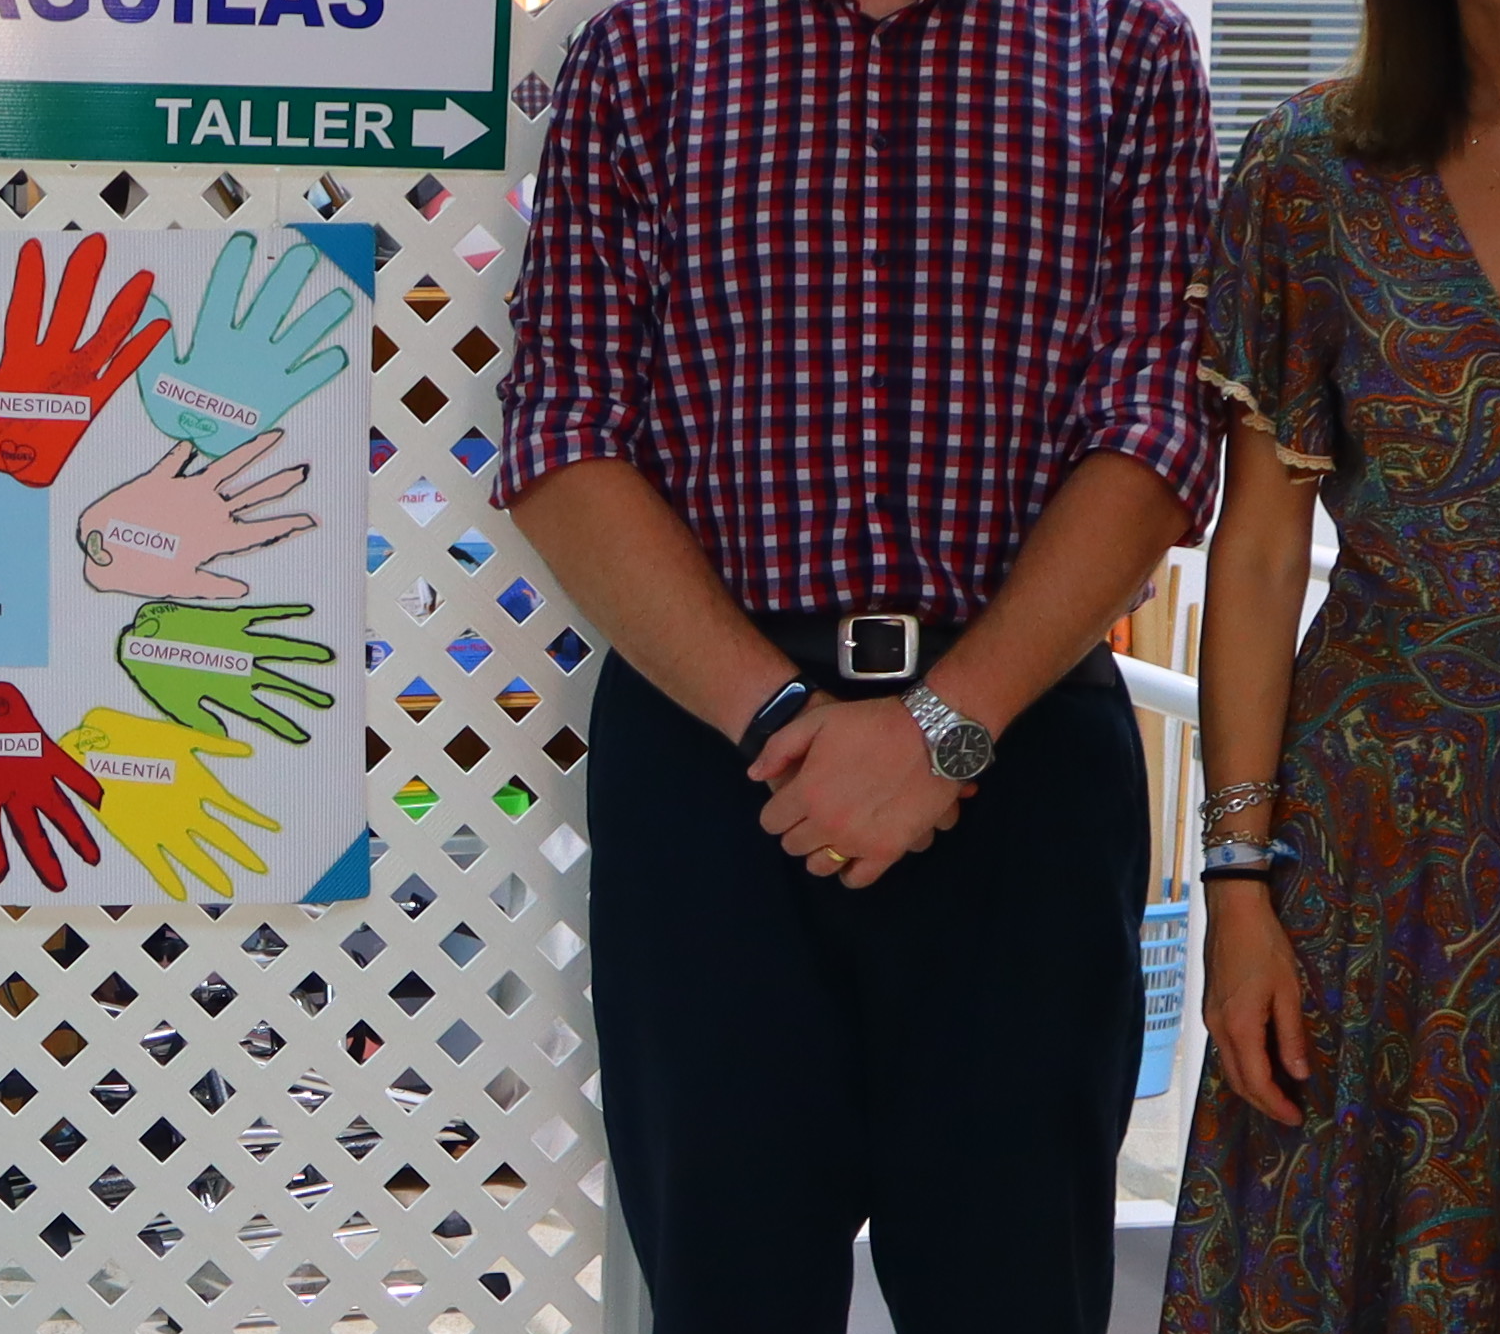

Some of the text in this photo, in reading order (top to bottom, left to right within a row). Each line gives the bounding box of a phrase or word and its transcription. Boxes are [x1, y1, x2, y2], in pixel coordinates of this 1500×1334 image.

[155, 97, 396, 151] TALLER
[156, 380, 258, 426] SINCERIDAD
[108, 527, 176, 552] ACCIÓN
[129, 641, 248, 671] COMPROMISO
[89, 759, 171, 781] VALENTÍA
